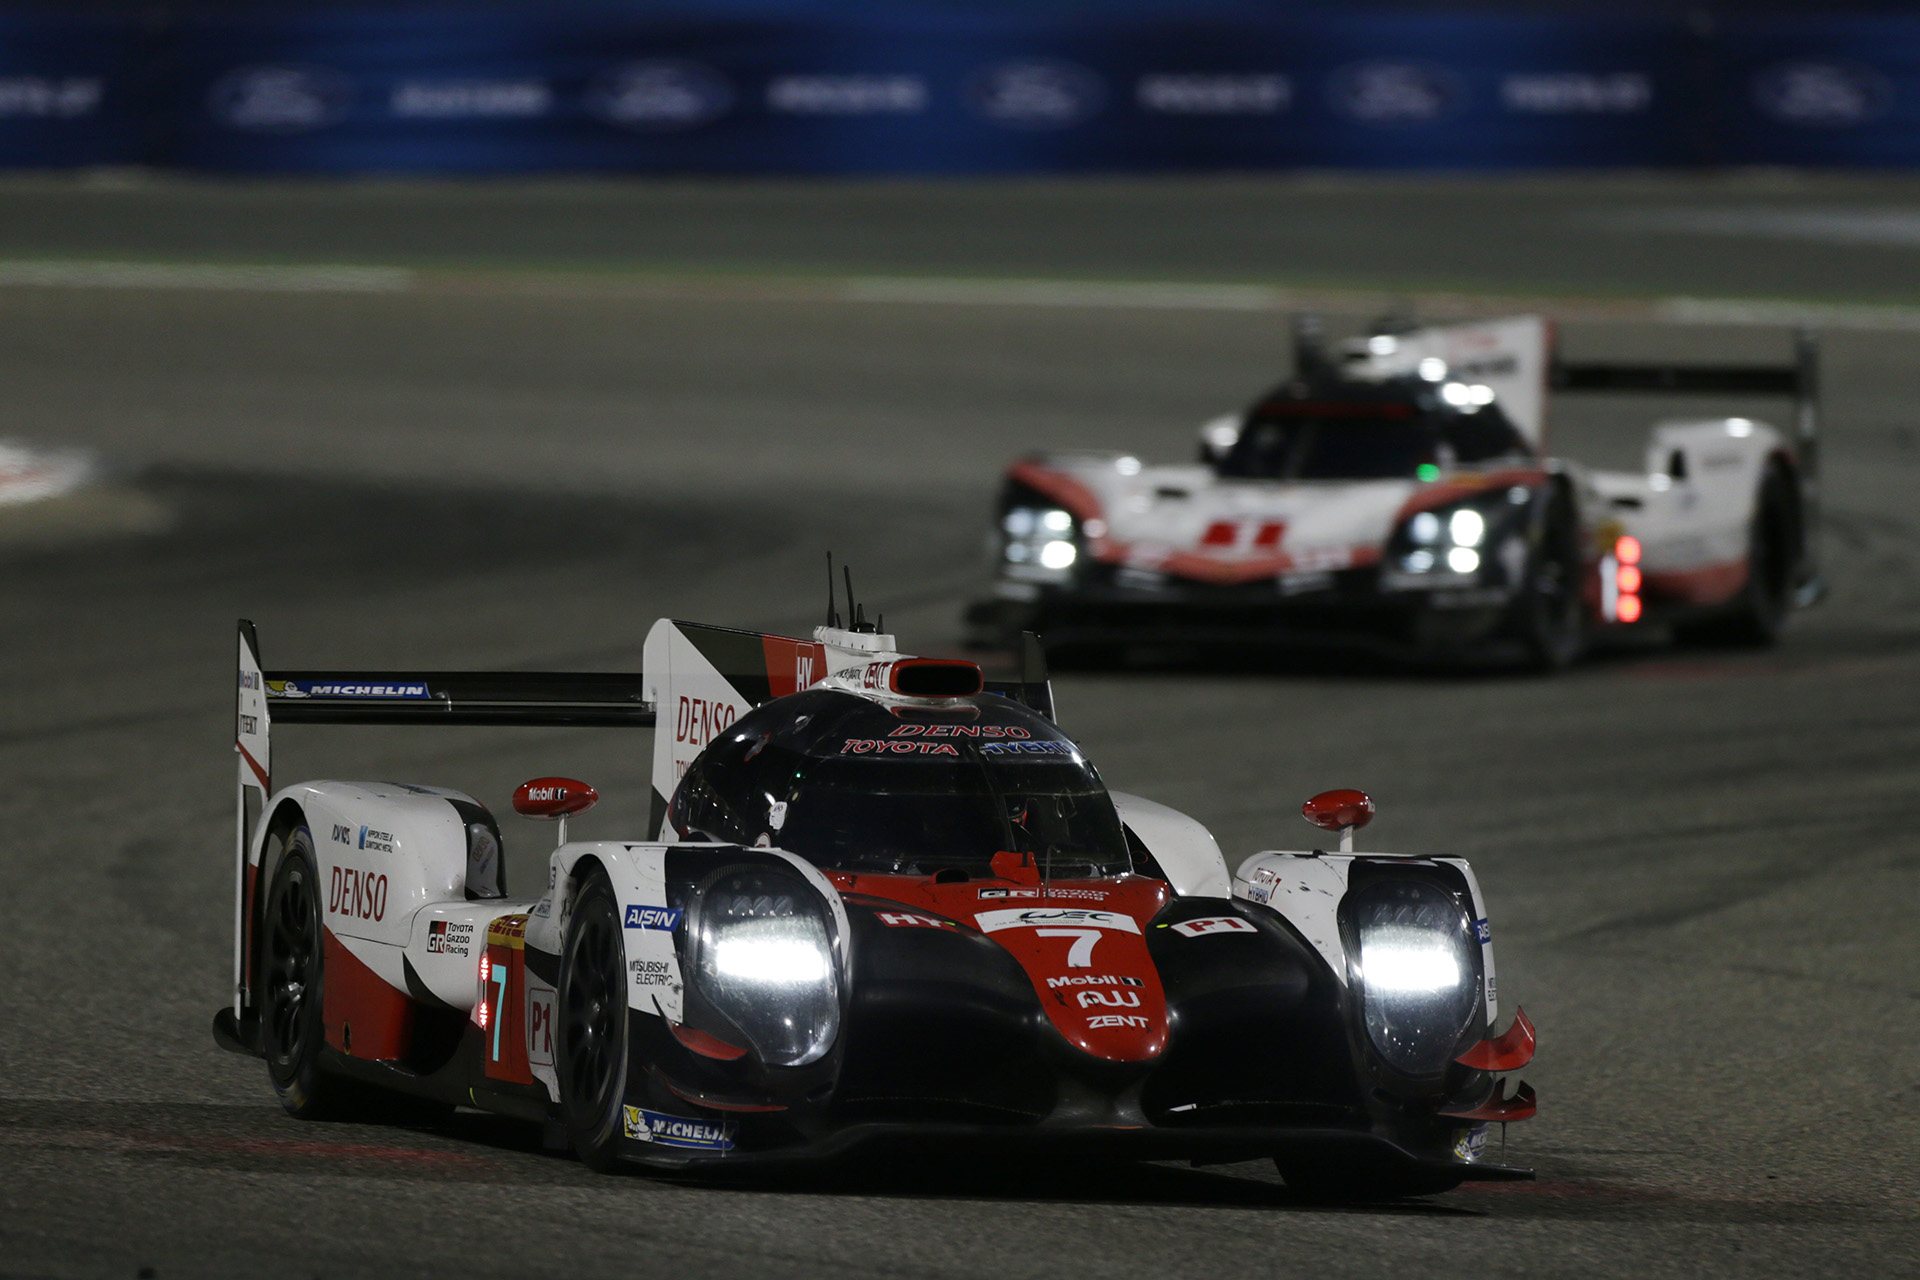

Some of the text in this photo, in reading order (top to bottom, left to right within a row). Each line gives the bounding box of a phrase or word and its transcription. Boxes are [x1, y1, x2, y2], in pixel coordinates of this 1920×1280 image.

[797, 657, 813, 692] HY
[311, 685, 424, 695] MICHELIN
[888, 725, 1031, 739] DENSO
[840, 739, 959, 755] TOYOTA
[529, 787, 553, 800] Mobil
[330, 866, 388, 922] DENSO
[627, 909, 676, 927] AISIN
[881, 913, 941, 927] HY
[1019, 910, 1113, 922] WEC
[448, 922, 474, 933] TOYOTA
[1184, 917, 1240, 932] P1
[428, 934, 445, 953] GR
[446, 934, 470, 944] GAZOO
[445, 945, 469, 957] Racing
[1035, 929, 1102, 967] 7
[629, 960, 669, 974] MITSUBISHI
[636, 973, 673, 986] ELECTRIC
[1046, 975, 1118, 988] Mobil
[491, 963, 507, 1062] 7
[531, 1001, 550, 1053] P1
[1086, 1015, 1149, 1029] ZENT
[652, 1119, 735, 1141] MICHELIN
